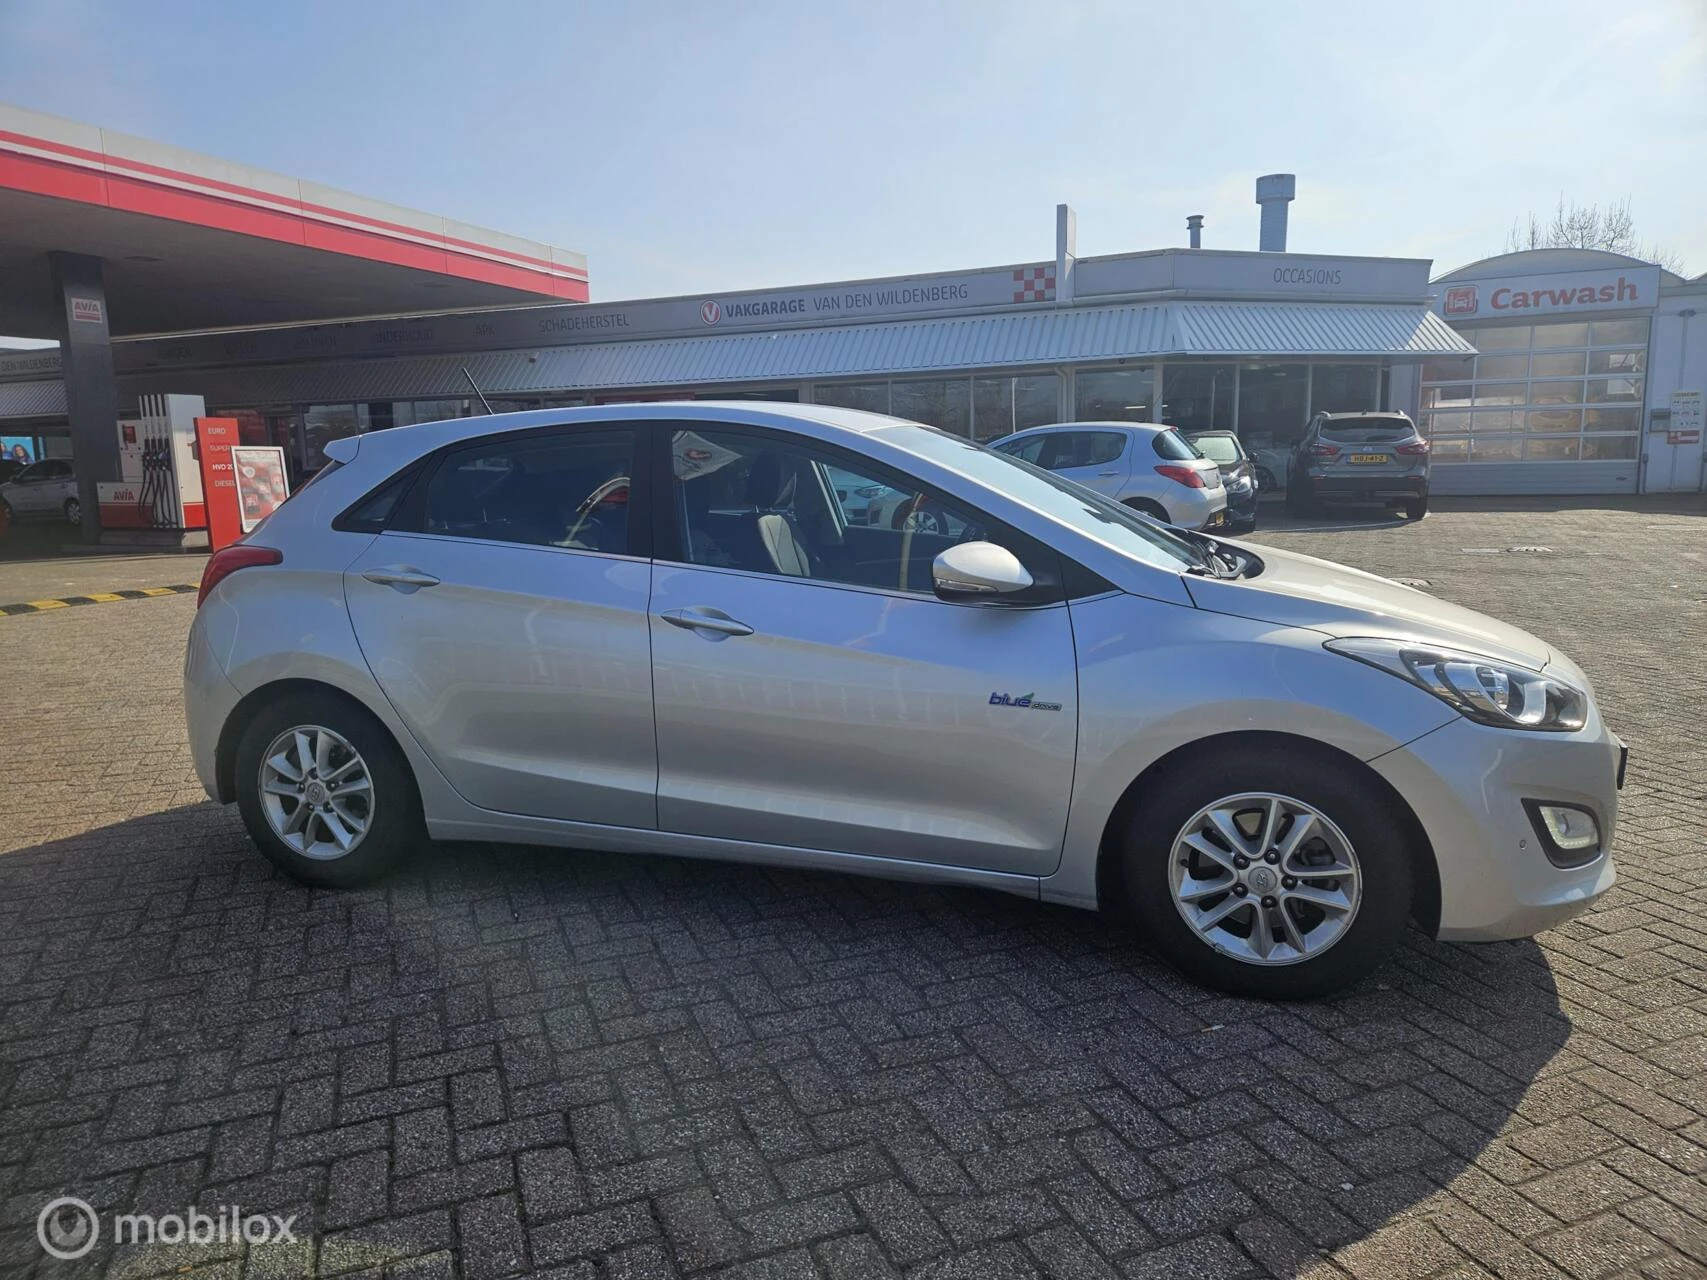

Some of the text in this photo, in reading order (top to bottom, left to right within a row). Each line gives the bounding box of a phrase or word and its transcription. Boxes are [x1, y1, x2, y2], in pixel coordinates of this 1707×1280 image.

[1273, 267, 1342, 285] OCCASIONS
[726, 283, 968, 318] VAKGARAGE VAN DEN WILDENBERG
[1491, 277, 1638, 310] Carwash
[75, 300, 100, 313] AVIA
[538, 313, 630, 333] SCHADEHERSTEL
[207, 427, 226, 435] EURO
[212, 463, 226, 471] HVO
[113, 488, 135, 501] AVIA
[989, 692, 1033, 708] blue
